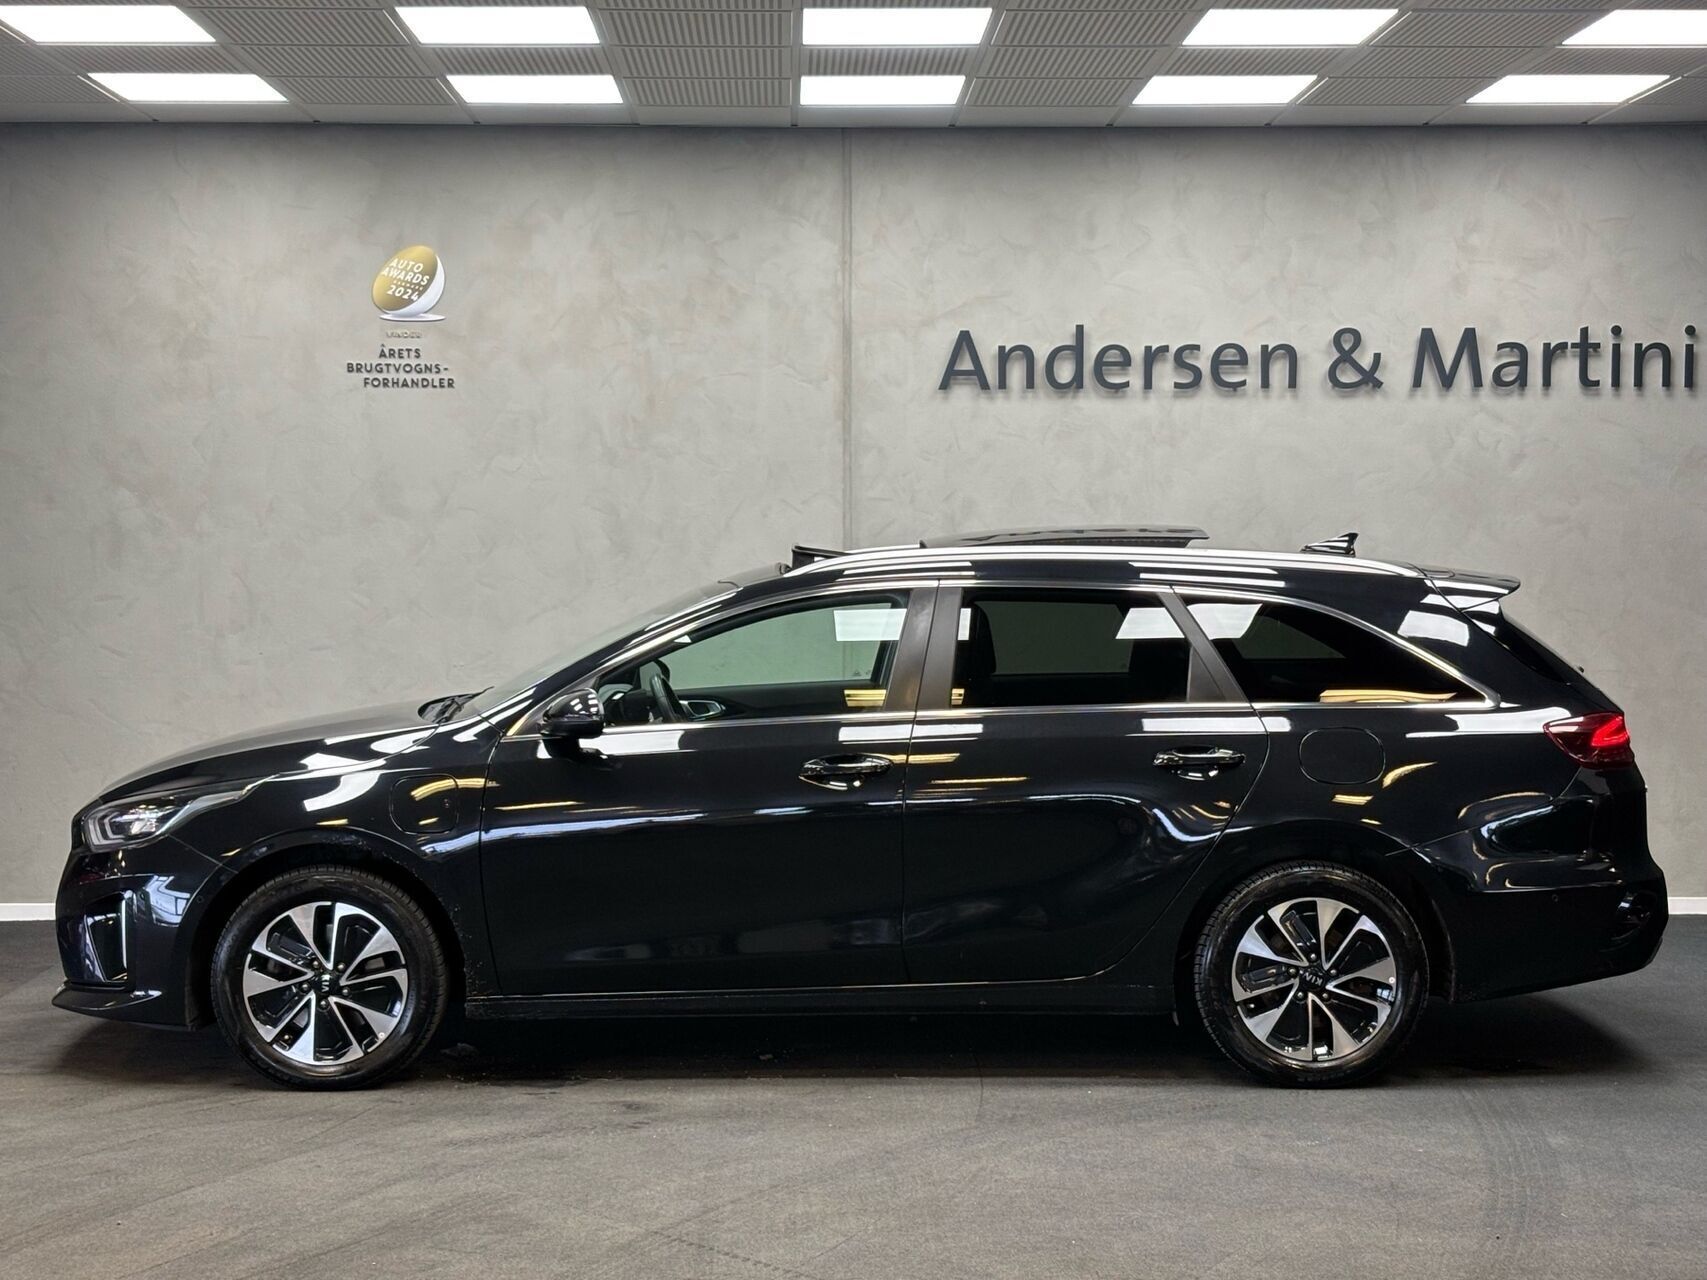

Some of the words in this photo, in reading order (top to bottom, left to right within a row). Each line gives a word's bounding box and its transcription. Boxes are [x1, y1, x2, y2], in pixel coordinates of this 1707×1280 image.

[389, 258, 424, 273] AUTO
[381, 267, 430, 286] AWARDS
[386, 284, 419, 301] 2024
[379, 343, 421, 359] ÅRETS
[938, 324, 1299, 391] Andersen
[1328, 327, 1384, 389] &
[1412, 324, 1697, 391] Martini
[346, 362, 449, 374] BRUGTVOGNS-
[363, 377, 455, 389] FORHANDLER
